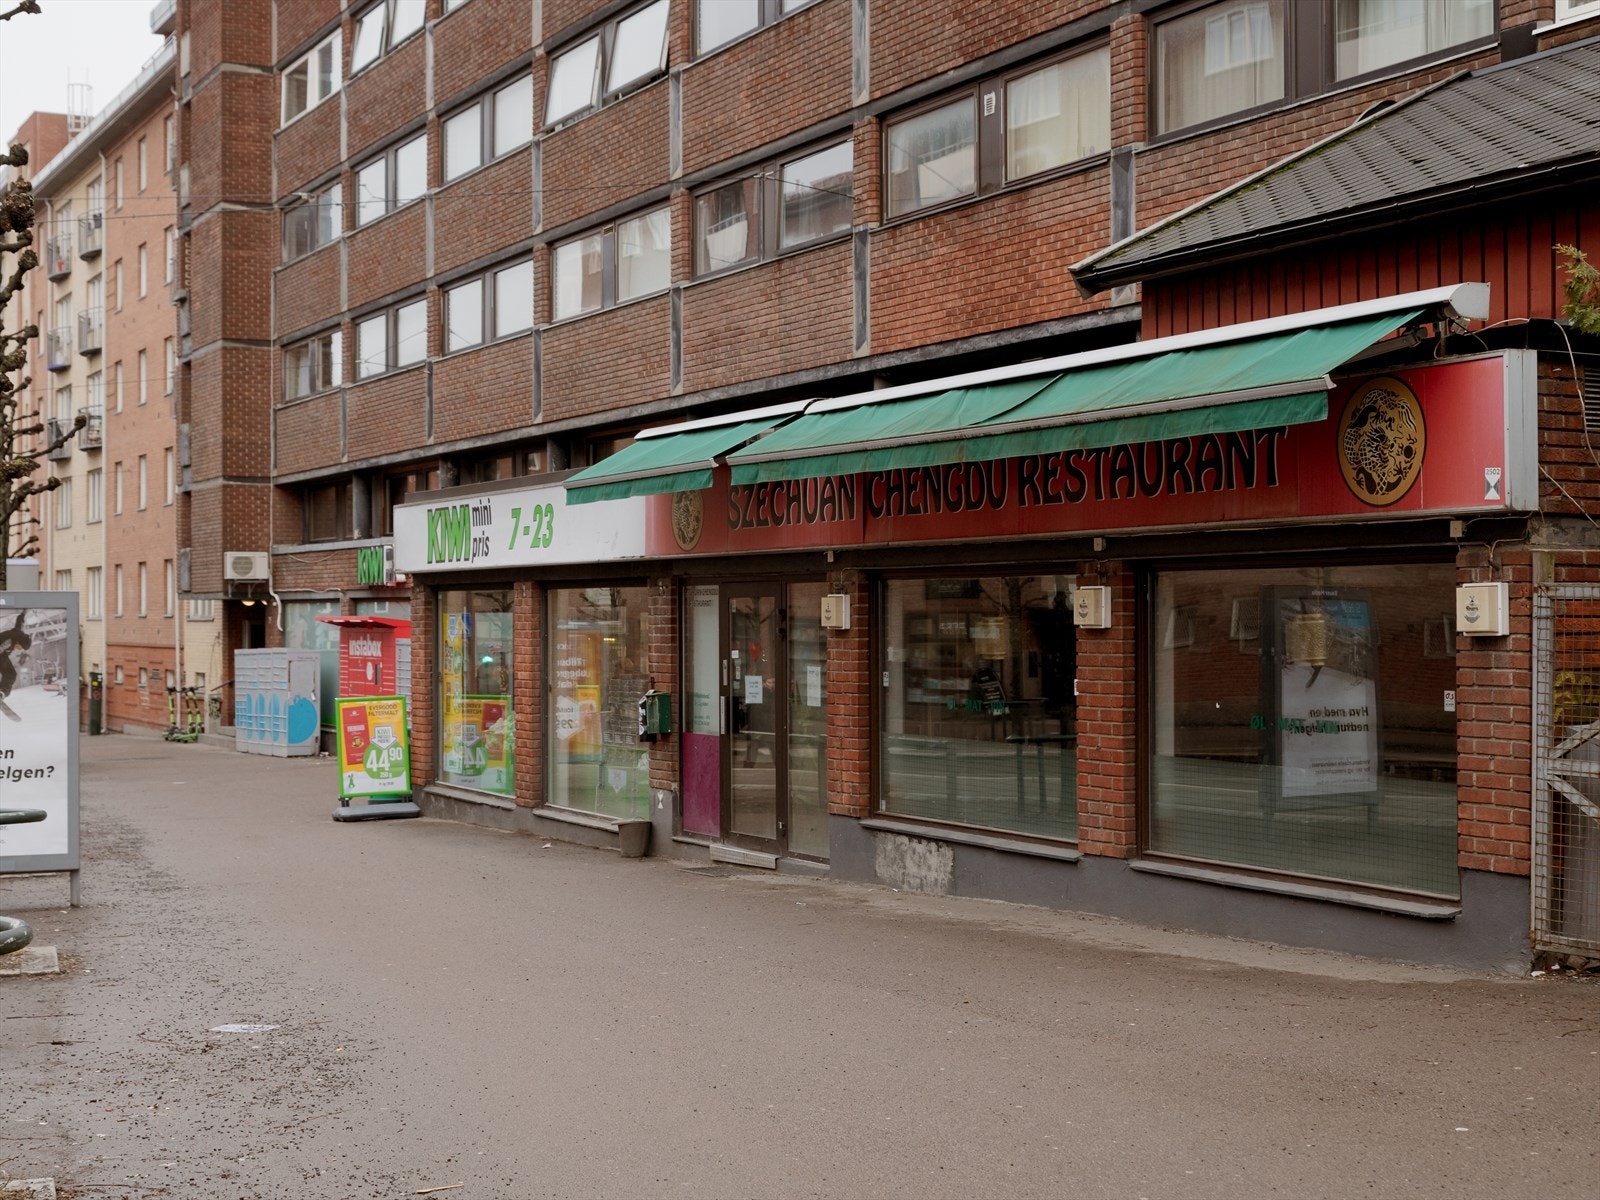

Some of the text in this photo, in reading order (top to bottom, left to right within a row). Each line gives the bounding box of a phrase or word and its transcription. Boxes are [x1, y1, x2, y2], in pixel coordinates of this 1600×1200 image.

[728, 426, 1289, 530] SZECHUAN CHENGDU RESTAURANT
[427, 504, 471, 564] KIWI
[472, 498, 492, 527] mini
[472, 531, 490, 563] pris
[357, 546, 384, 585] KIWI
[349, 634, 382, 657] instabox
